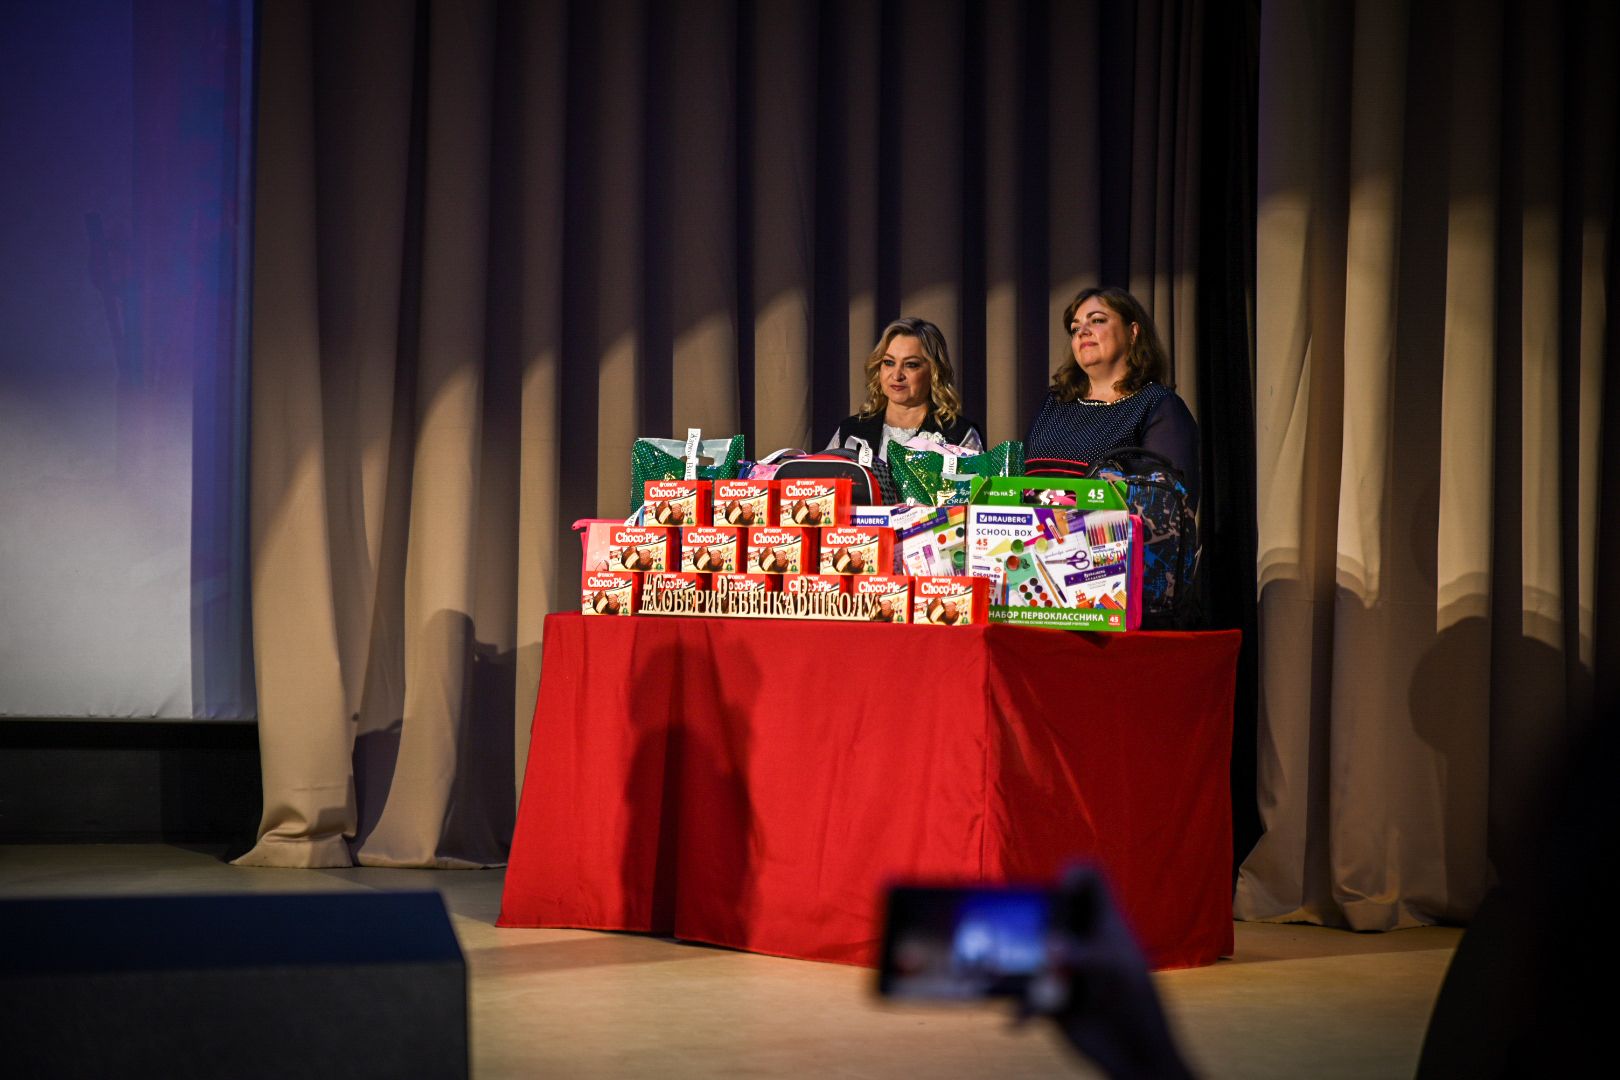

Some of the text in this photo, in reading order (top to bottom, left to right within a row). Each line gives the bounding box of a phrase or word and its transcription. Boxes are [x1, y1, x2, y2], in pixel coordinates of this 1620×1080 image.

[1088, 489, 1104, 499] 45
[987, 516, 1026, 524] BRAUBERG
[976, 528, 1032, 537] SCHOOL BOX
[976, 538, 988, 546] 45
[989, 610, 1104, 622] НАБОР ПЕРВОКЛАССНИКА
